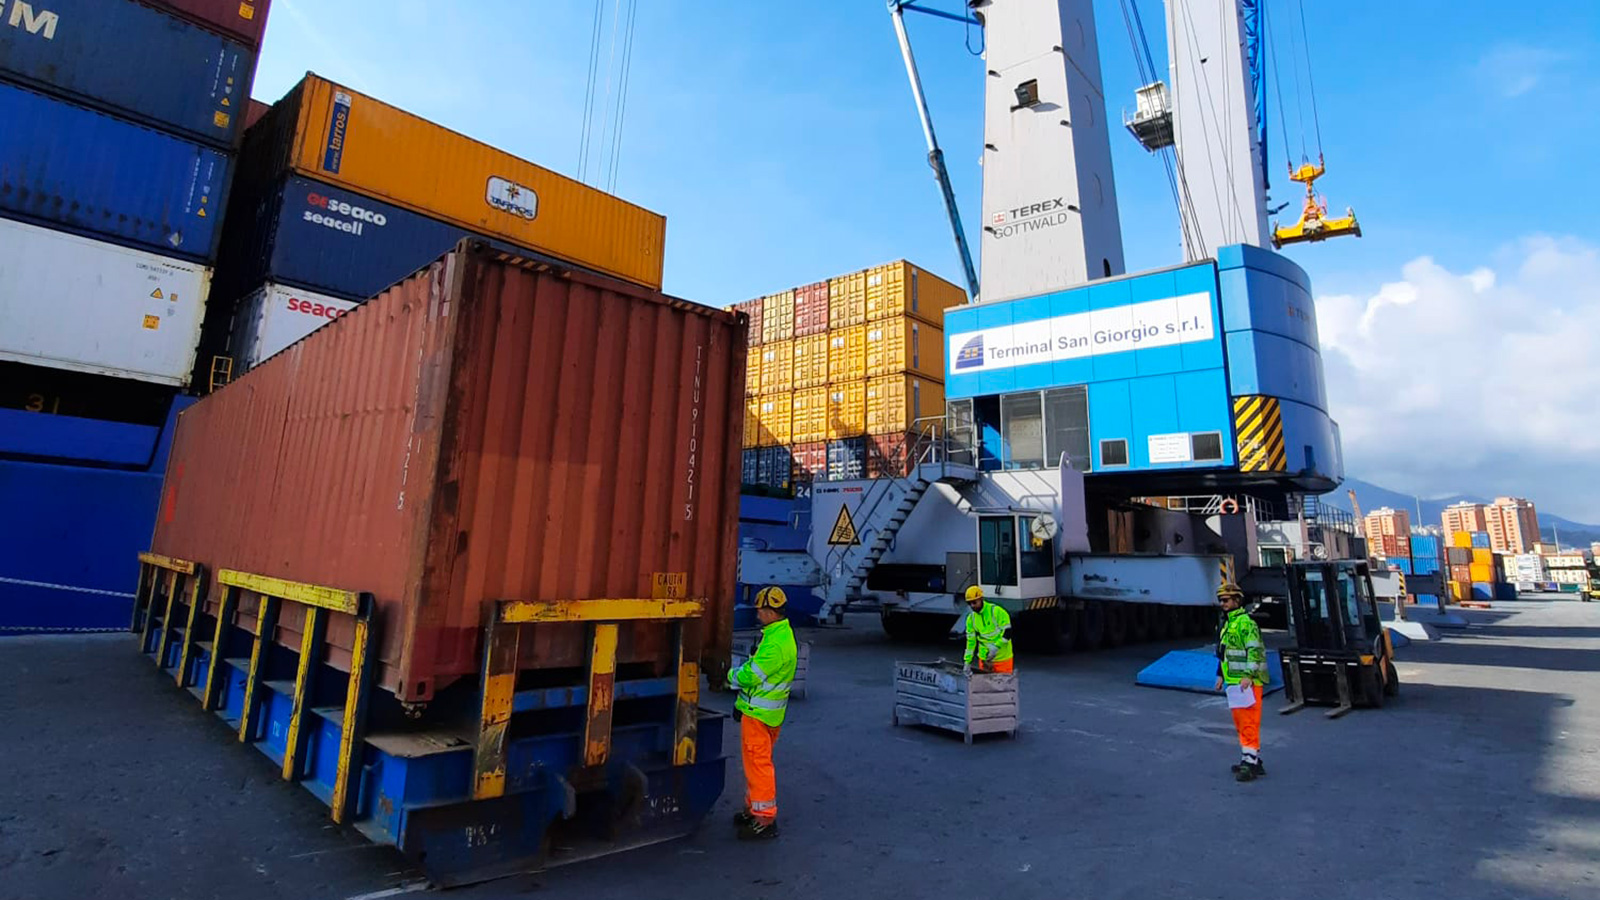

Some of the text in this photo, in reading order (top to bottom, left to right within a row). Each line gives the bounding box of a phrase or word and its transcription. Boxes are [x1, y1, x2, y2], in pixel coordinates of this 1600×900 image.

[0, 0, 59, 40] M
[1010, 197, 1064, 219] TEREX
[303, 210, 363, 236] seacell
[993, 212, 1068, 239] GOTTWALD
[988, 315, 1204, 360] Terminal San Giorgio s.r.l.
[684, 345, 702, 520] TTNU 910421 5
[796, 486, 811, 498] 24
